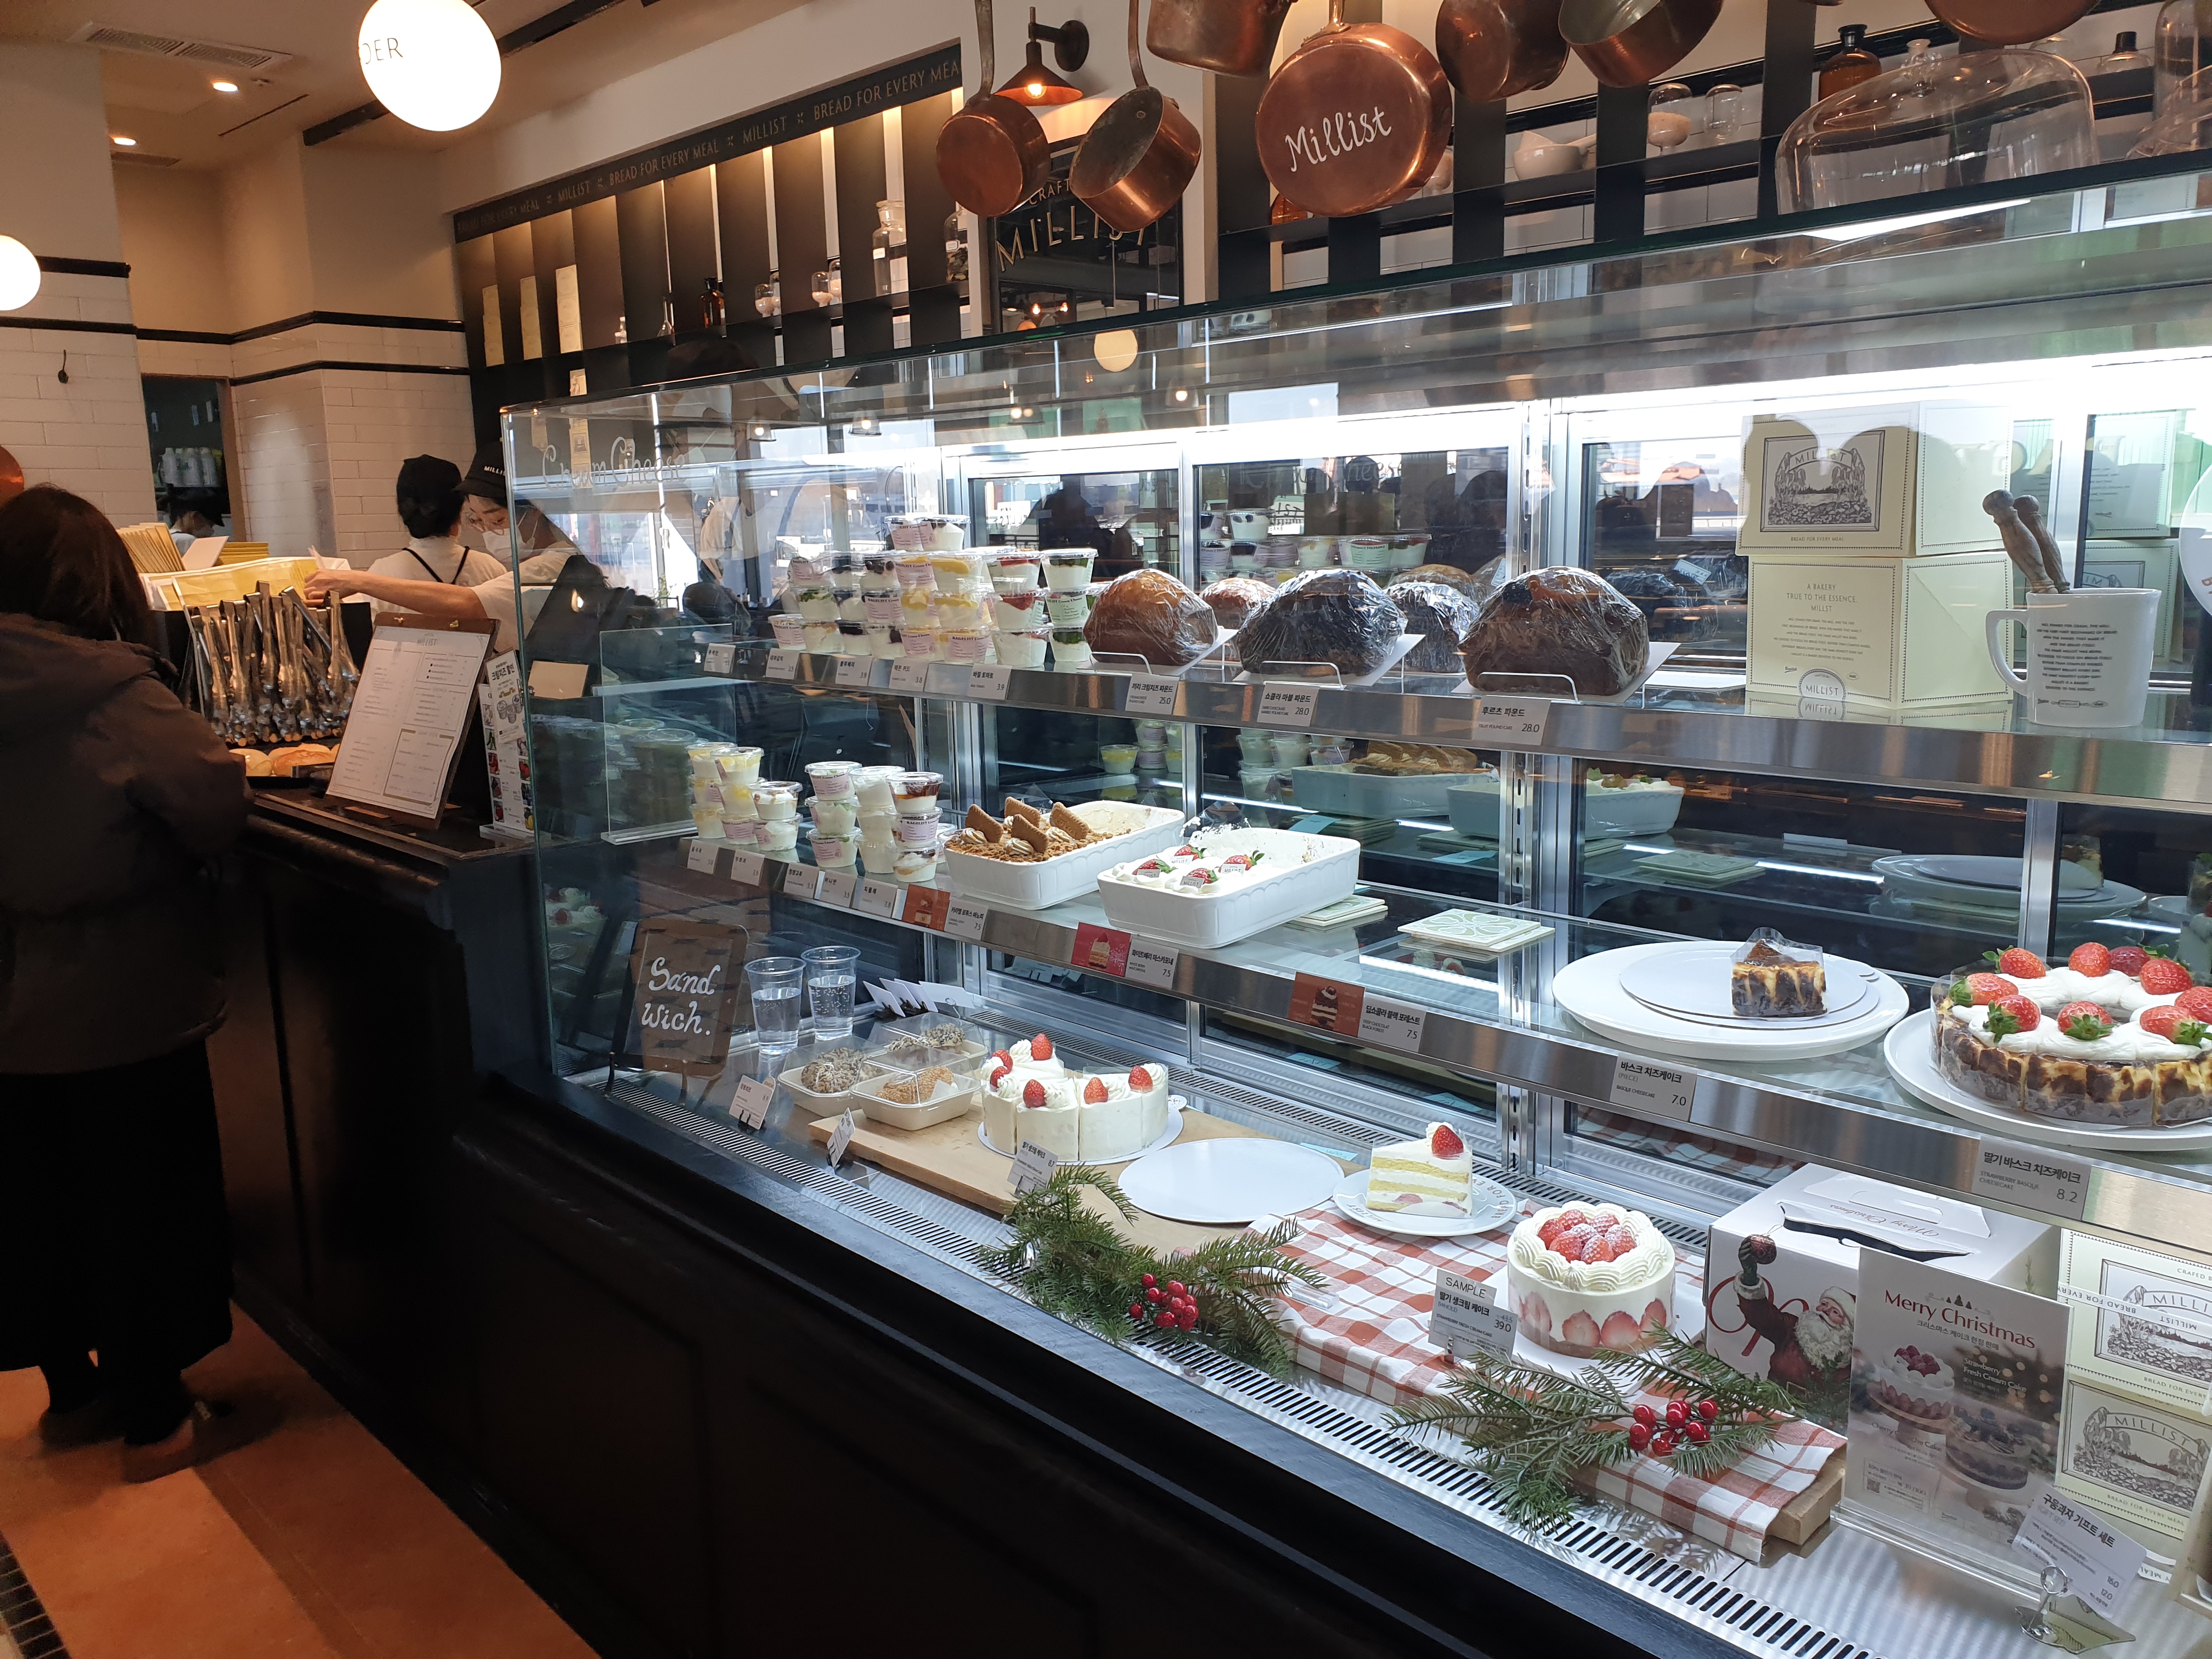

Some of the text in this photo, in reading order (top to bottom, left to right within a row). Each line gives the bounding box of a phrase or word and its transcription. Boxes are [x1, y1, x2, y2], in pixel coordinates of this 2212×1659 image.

[557, 181, 590, 202] MILLIST
[609, 166, 637, 186] BREAD
[641, 162, 658, 176] FOR
[661, 148, 690, 170] EVERY
[693, 141, 719, 160] MEAL
[743, 116, 787, 144] MILLIST
[813, 95, 852, 121] BREAD
[856, 84, 882, 107] FOR
[886, 70, 926, 97] EVERY
[1285, 106, 1392, 172] Millist
[542, 436, 687, 489] Cream Cheese
[1141, 684, 1159, 692] 크림치즈
[1805, 685, 1838, 696] MILLIST
[1159, 697, 1171, 705] 25.0
[1265, 693, 1311, 703] 쇼콜라 마블 파운드
[1295, 707, 1310, 715] 28.0
[1482, 706, 1525, 716] 후르츠 파운드
[1521, 723, 1540, 733] 28.0
[962, 909, 972, 918] 로투스
[1152, 955, 1174, 966] 마스카포네
[648, 957, 721, 995] Sand
[1163, 968, 1171, 977] 7.5
[1365, 1005, 1421, 1025] 딥쇼콜라 블랙 포레스트
[1407, 1029, 1418, 1039] 7.5
[1618, 1072, 1639, 1082] (PIECE)
[1621, 1062, 1683, 1084] 바스크 치즈케이크
[1616, 1085, 1632, 1093] BASQUE
[1671, 1094, 1687, 1106] 7.0
[1984, 1151, 2081, 1184] 딸기 바스크 치즈케이크
[1979, 1177, 2015, 1190] CHEESECAKE
[1980, 1170, 2040, 1190] STRAWBERRY BASQUE
[2056, 1188, 2078, 1204] 8.2
[2176, 1267, 2206, 1280] CRAFED
[1445, 1277, 1487, 1299] SAMPLE
[1440, 1291, 1490, 1317] 딸기 생크림 케이크
[2057, 1286, 2198, 1331] MILLIST BREAD FOR EVERY
[1494, 1319, 1512, 1333] 39.0
[1884, 1289, 2036, 1349] Merry Christmas
[1458, 1321, 1470, 1329] FRESH
[1469, 1325, 1483, 1334] CREAM
[1916, 1319, 2000, 1351] 크리스마스 케이크 한정 판매
[1964, 1357, 2001, 1376] Strawberry
[1963, 1365, 2027, 1392] Fresh Cream Cake
[2143, 1376, 2167, 1387] BREAD
[2168, 1383, 2183, 1392] FOR
[2113, 1415, 2191, 1447] MILLIST
[1925, 1441, 1943, 1452] Cake
[2107, 1494, 2185, 1526] BREAD FOR EVERY MEAL
[2043, 1493, 2075, 1521] 구움과자
[2073, 1514, 2099, 1537] 기프트
[2098, 1531, 2116, 1548] 세트
